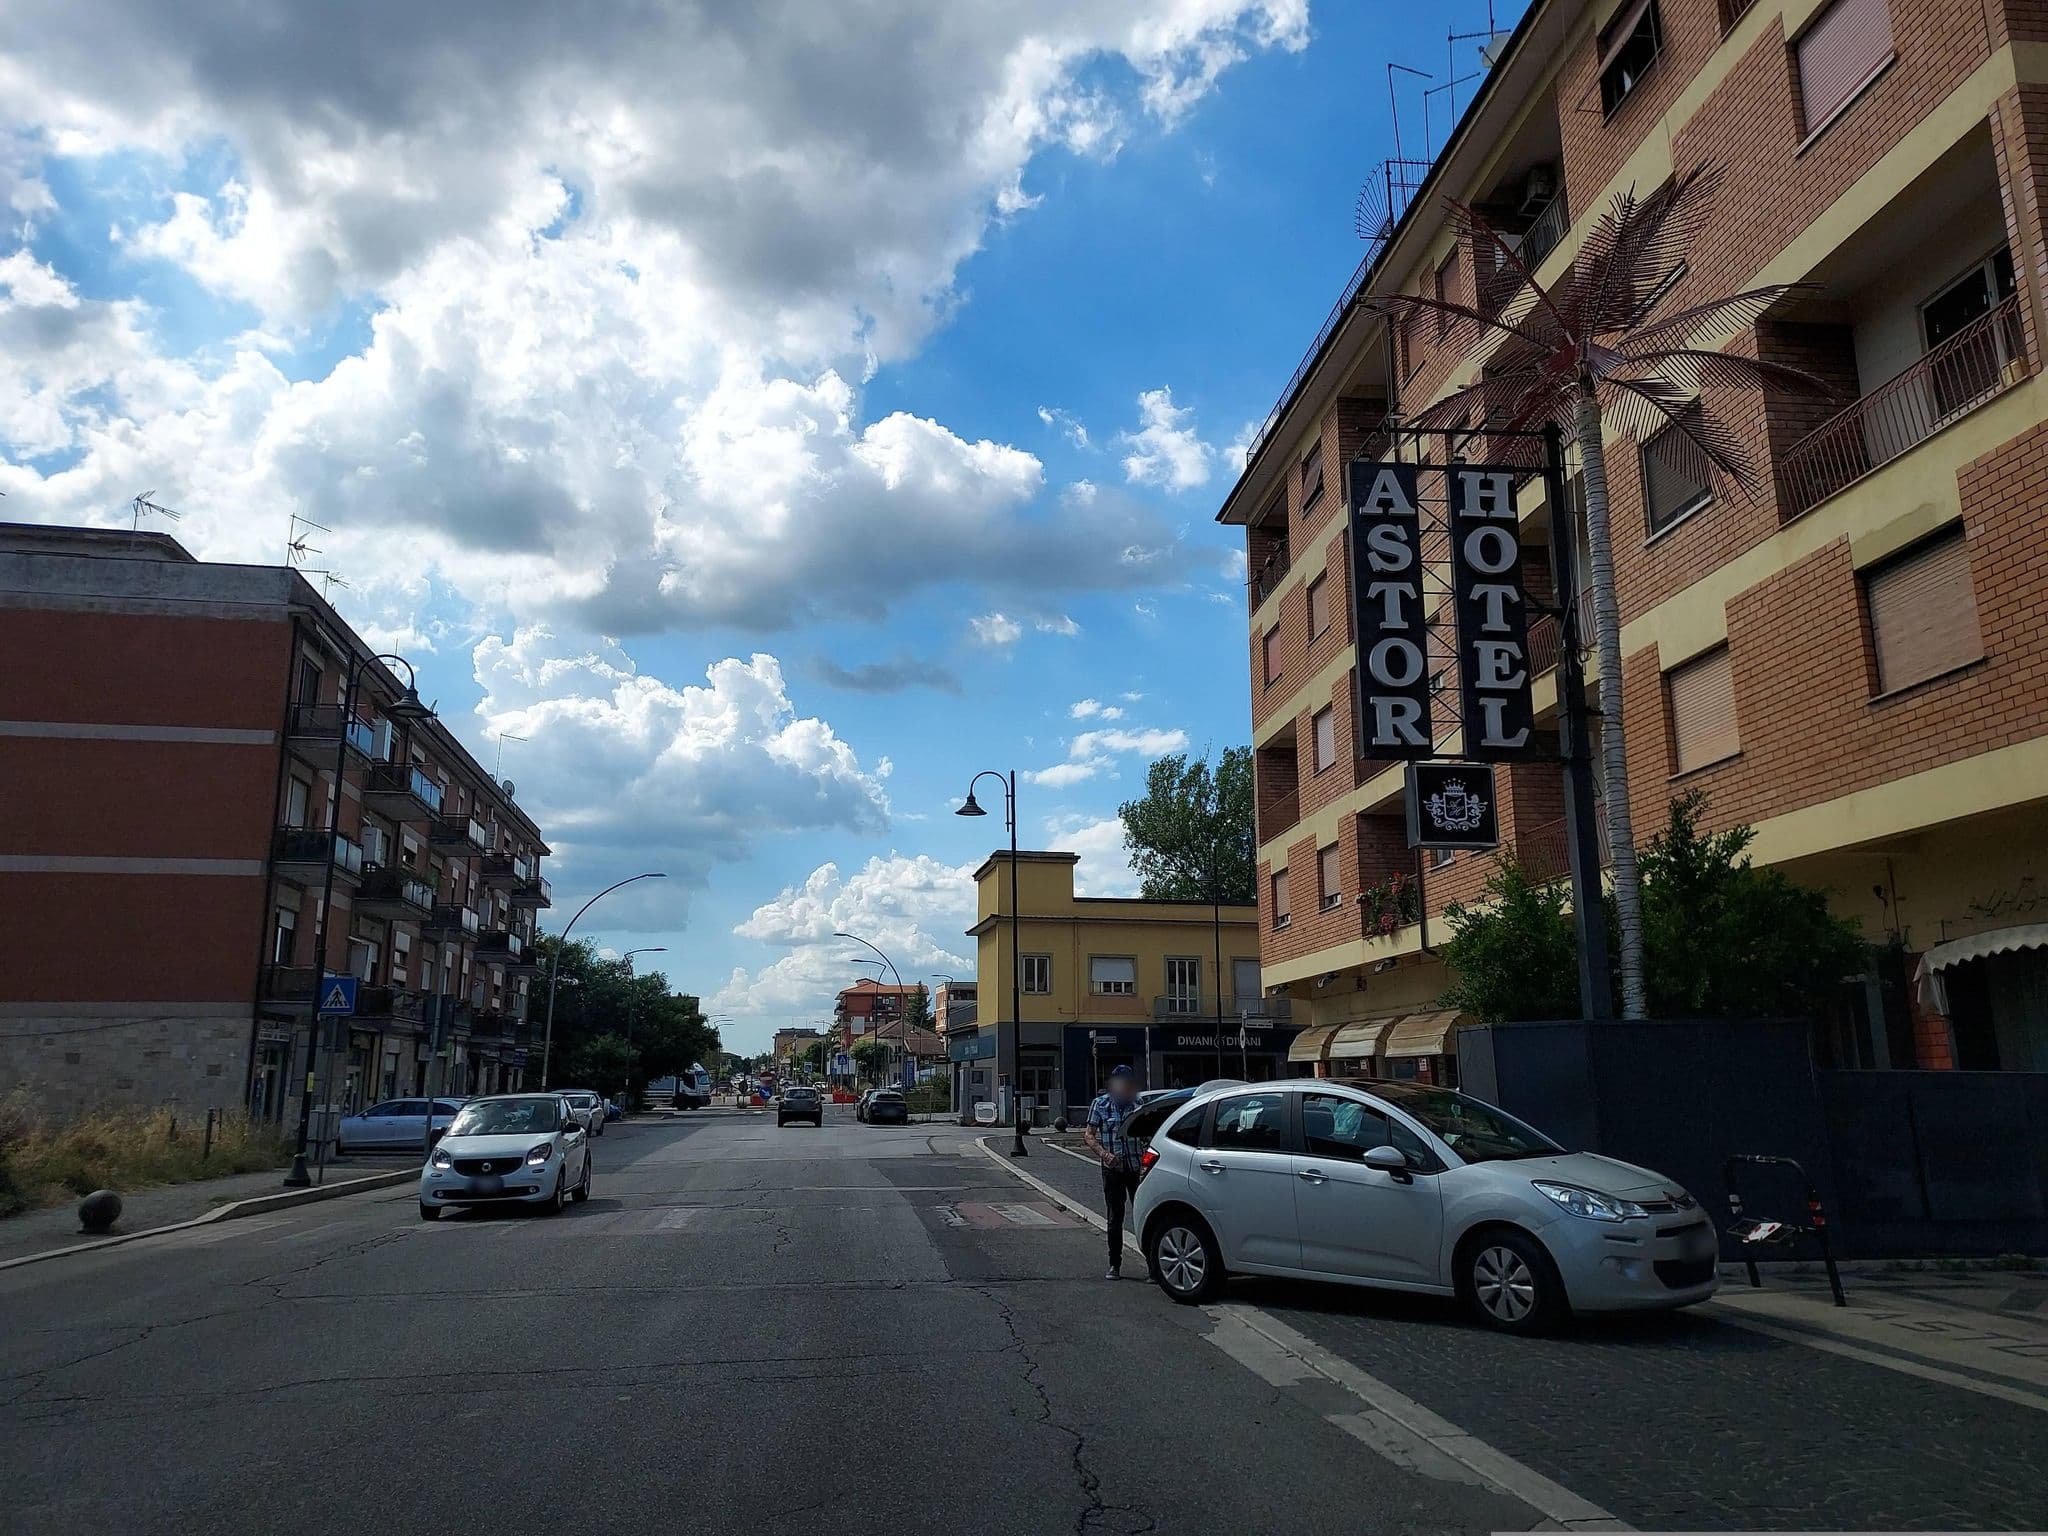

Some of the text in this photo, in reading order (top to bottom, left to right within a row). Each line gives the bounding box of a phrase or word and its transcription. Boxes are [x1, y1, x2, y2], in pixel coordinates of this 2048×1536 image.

[1359, 469, 1430, 746] ASTOR
[1458, 471, 1530, 748] HOTEL
[1177, 1035, 1213, 1046] DIVANI
